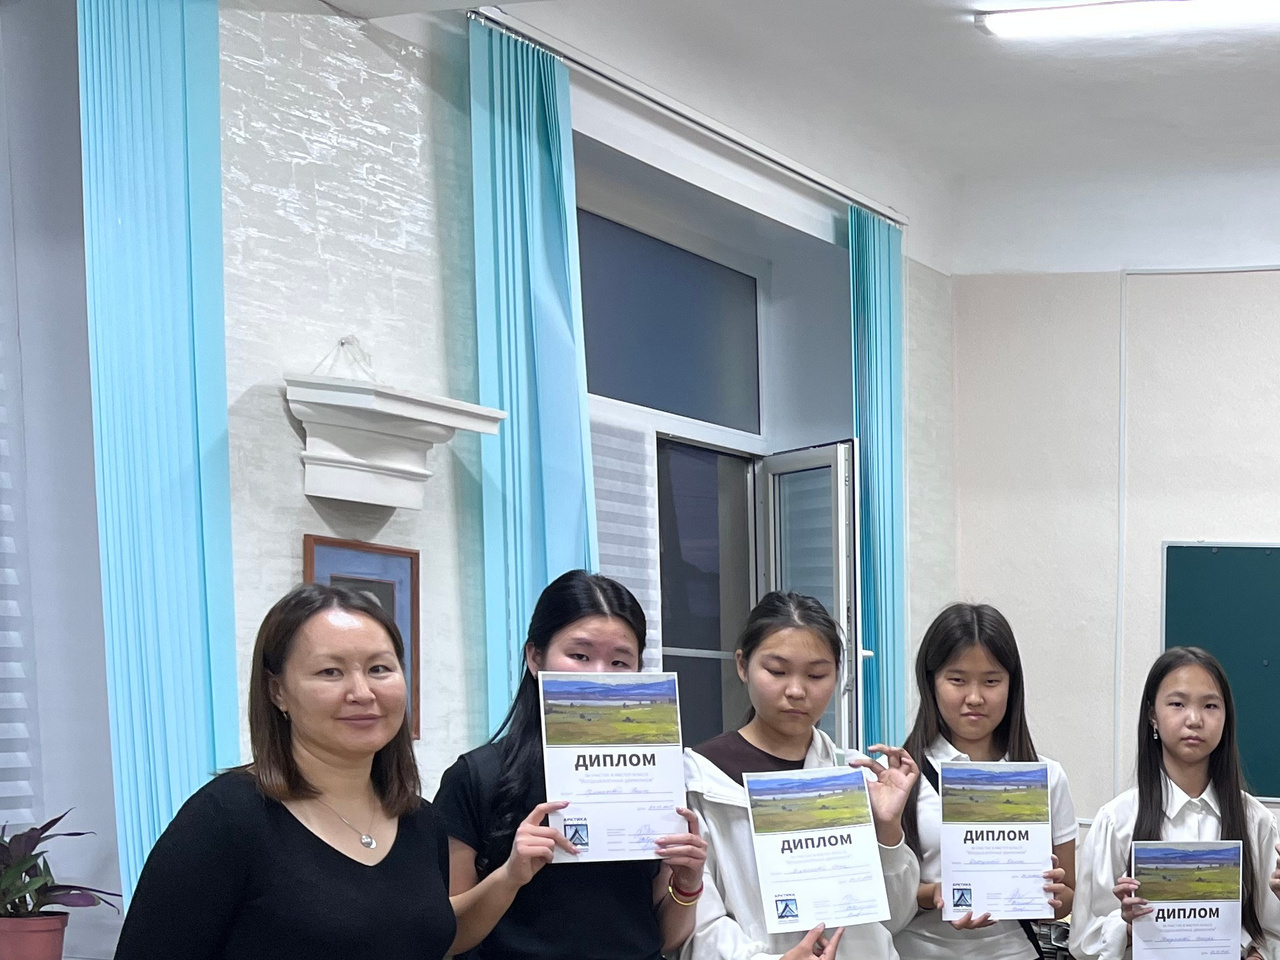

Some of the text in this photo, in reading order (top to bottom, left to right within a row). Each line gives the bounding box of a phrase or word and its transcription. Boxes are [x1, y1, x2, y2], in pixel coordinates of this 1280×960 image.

[574, 753, 656, 771] ДИПЛОМ
[780, 834, 853, 854] ДИПЛОМ
[963, 829, 1030, 844] ДИПЛОМ
[1155, 907, 1220, 922] ДИПЛОМ
